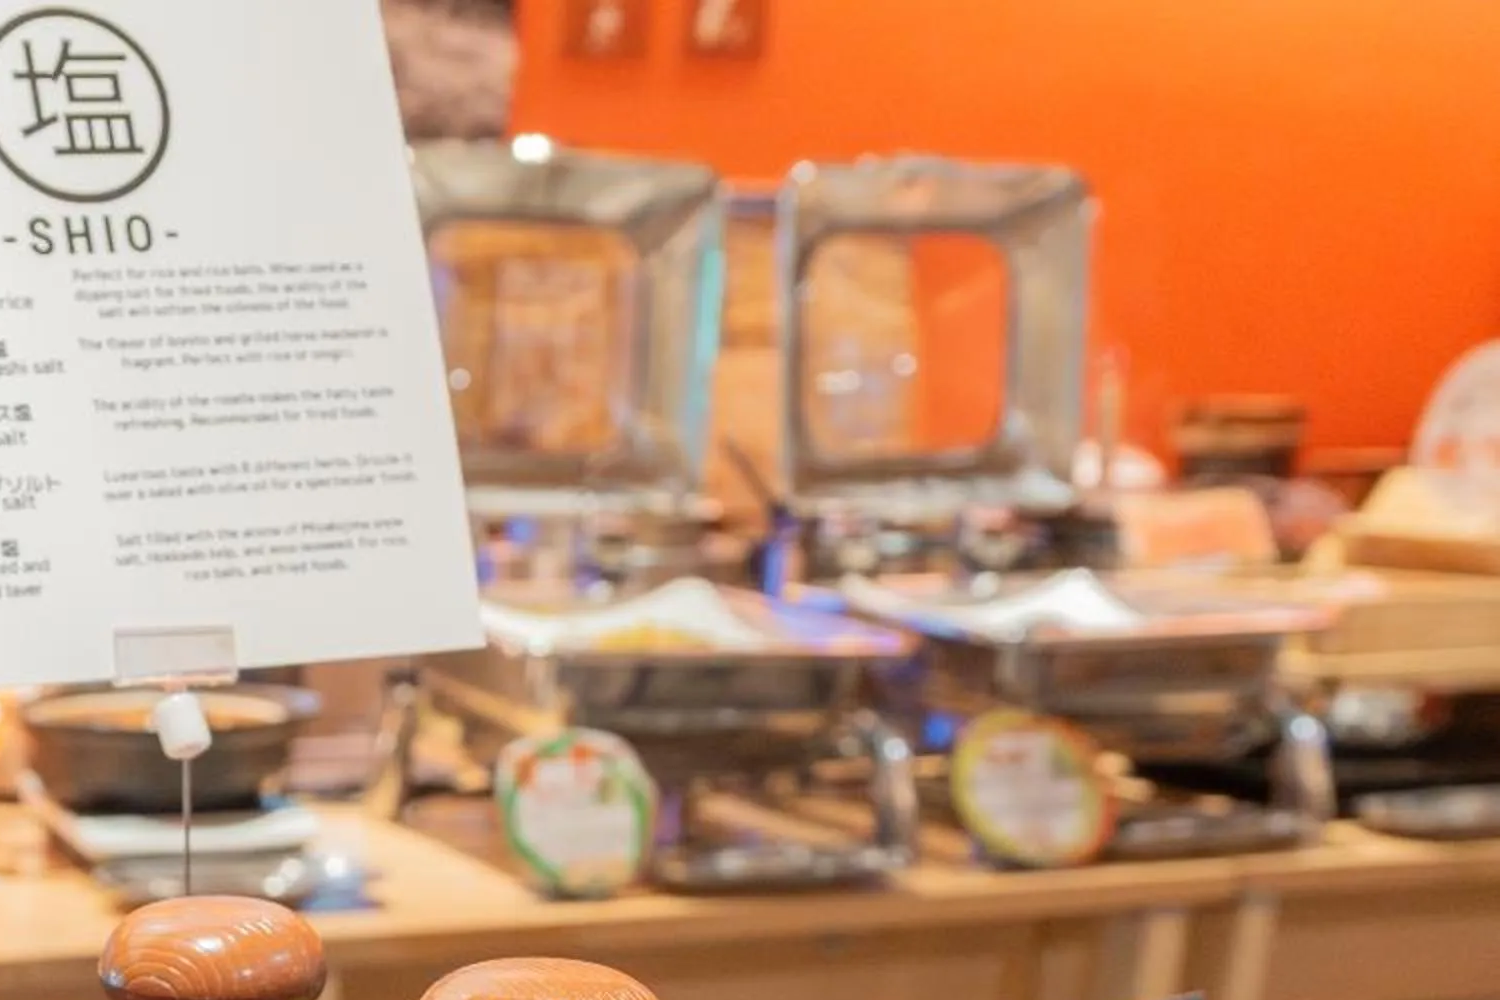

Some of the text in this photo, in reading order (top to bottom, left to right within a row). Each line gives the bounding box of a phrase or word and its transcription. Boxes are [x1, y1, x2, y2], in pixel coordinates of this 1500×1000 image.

[13, 41, 144, 156] 塩
[33, 360, 65, 375] salt
[2, 495, 36, 511] salt
